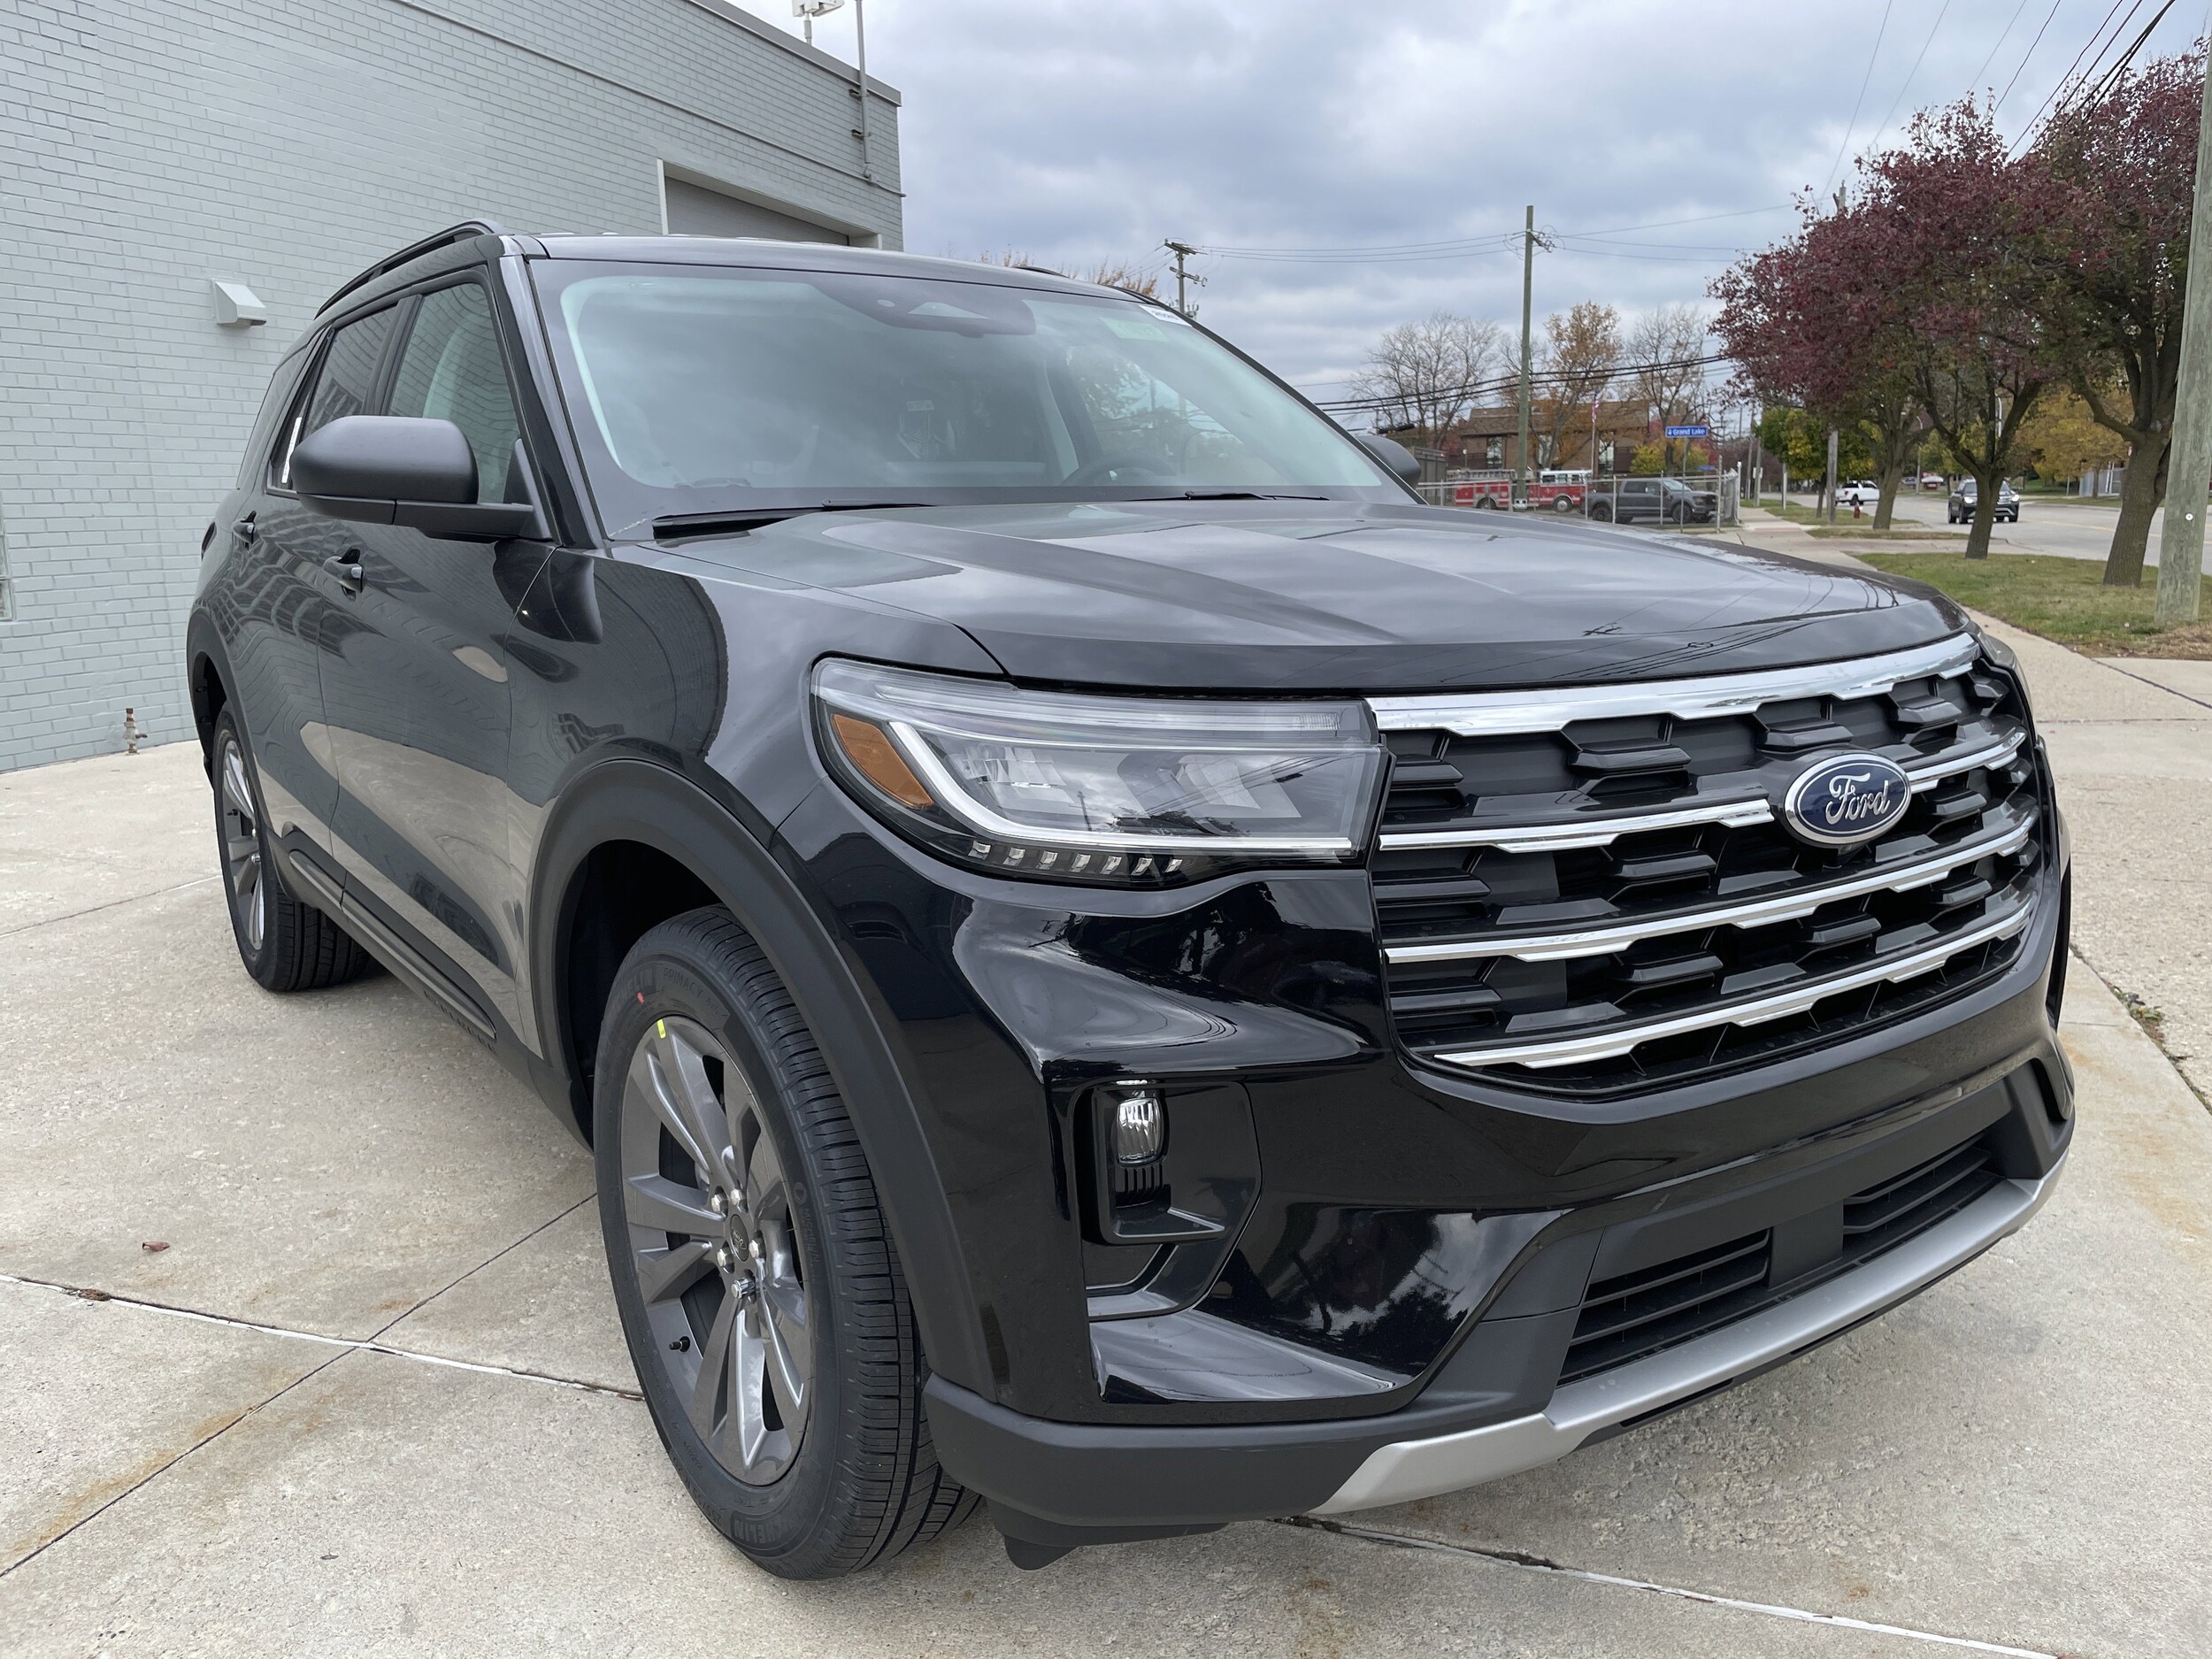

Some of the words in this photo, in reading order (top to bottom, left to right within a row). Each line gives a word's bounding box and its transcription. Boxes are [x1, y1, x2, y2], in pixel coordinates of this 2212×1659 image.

[1825, 772, 1891, 826] Ford
[663, 967, 704, 998] PRIMACY
[734, 1517, 800, 1544] CHELIN
